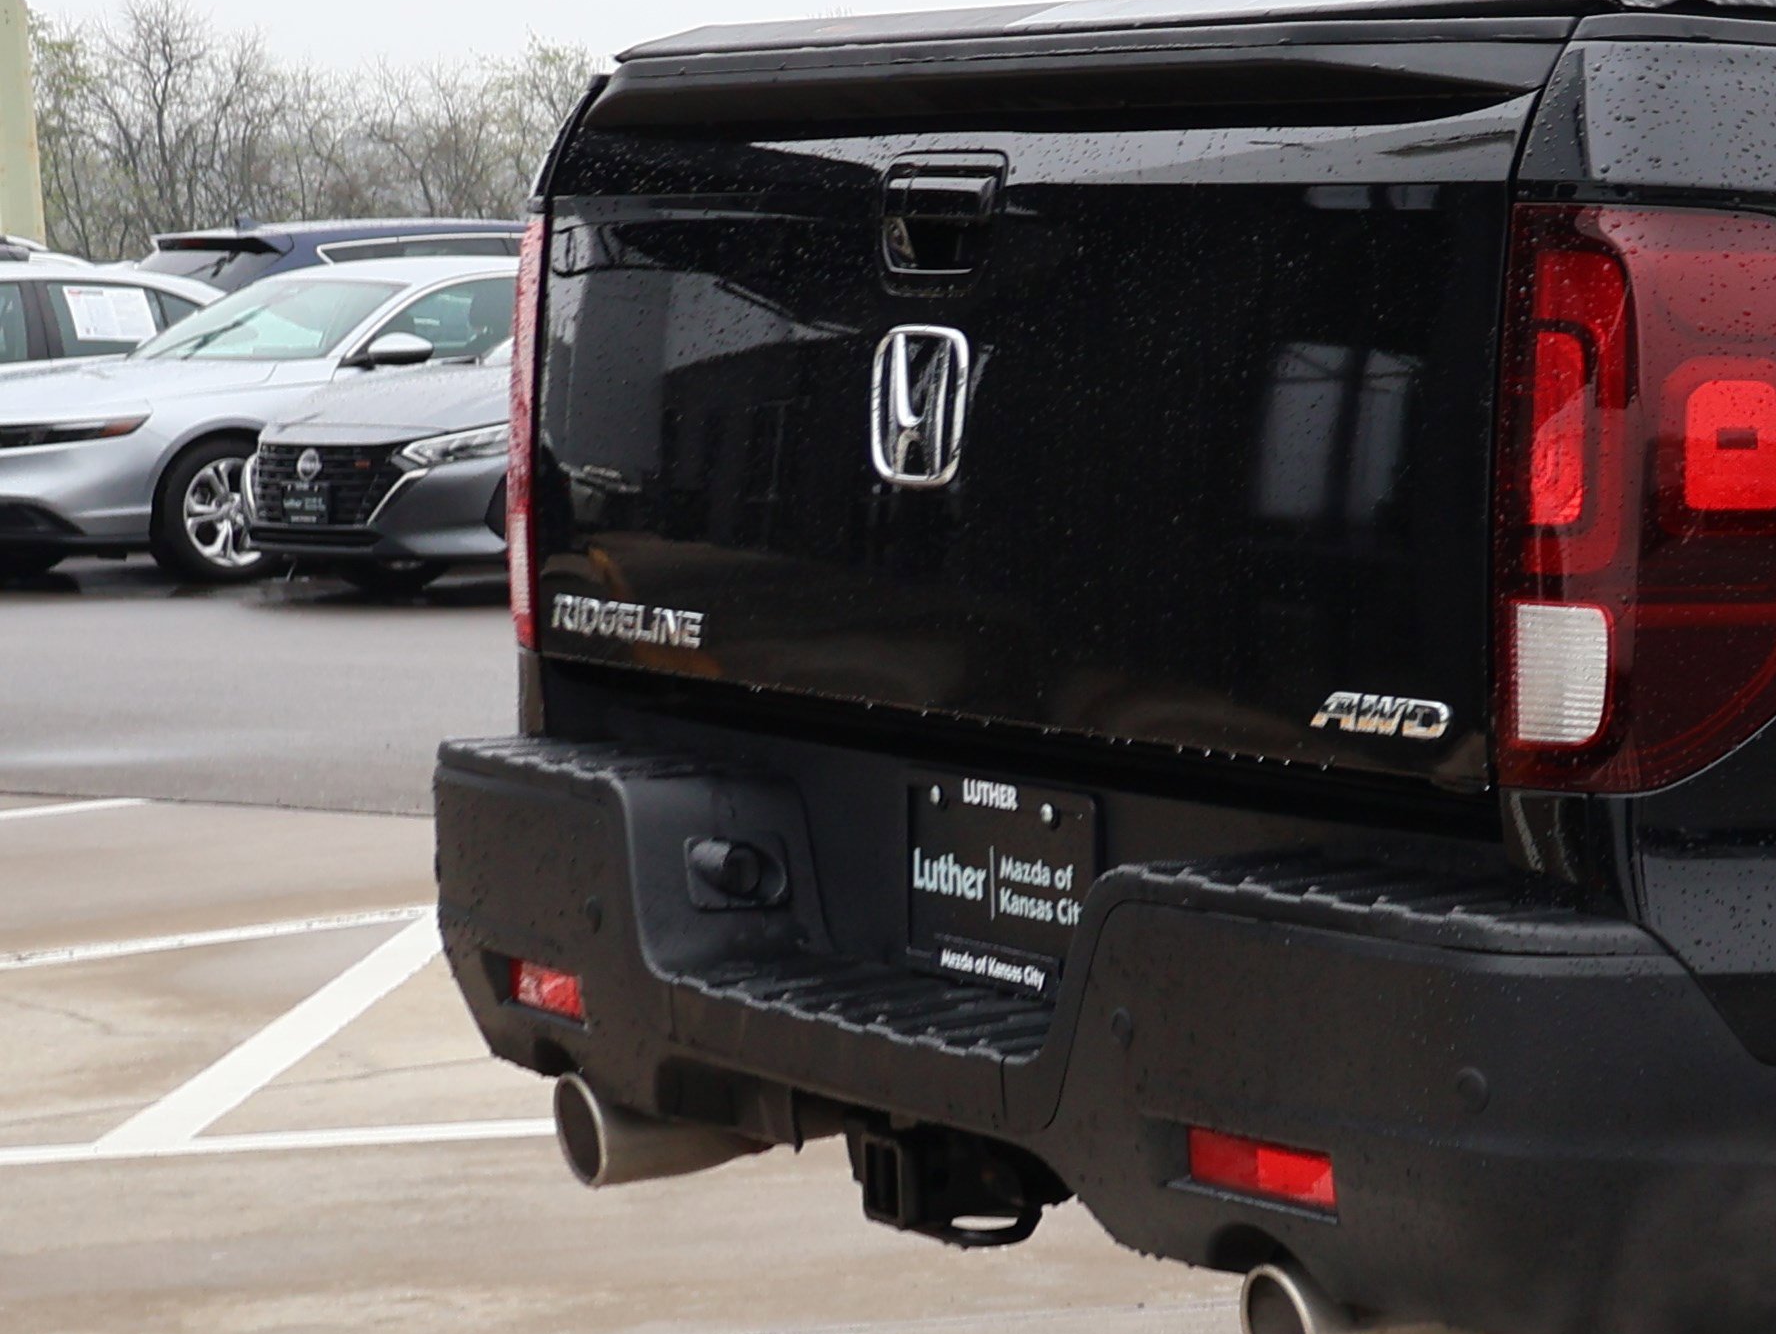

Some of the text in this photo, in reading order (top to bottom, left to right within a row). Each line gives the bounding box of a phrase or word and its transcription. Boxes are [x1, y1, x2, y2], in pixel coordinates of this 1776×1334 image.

[550, 592, 704, 650] RIDGELINE
[1310, 691, 1451, 740] AWD
[962, 777, 1019, 812] LUTHER
[913, 847, 986, 901] Luther
[1000, 854, 1074, 891] Mazda of
[1000, 886, 1083, 926] Kansas Cit
[941, 948, 1046, 992] Mazda of Kansas City
